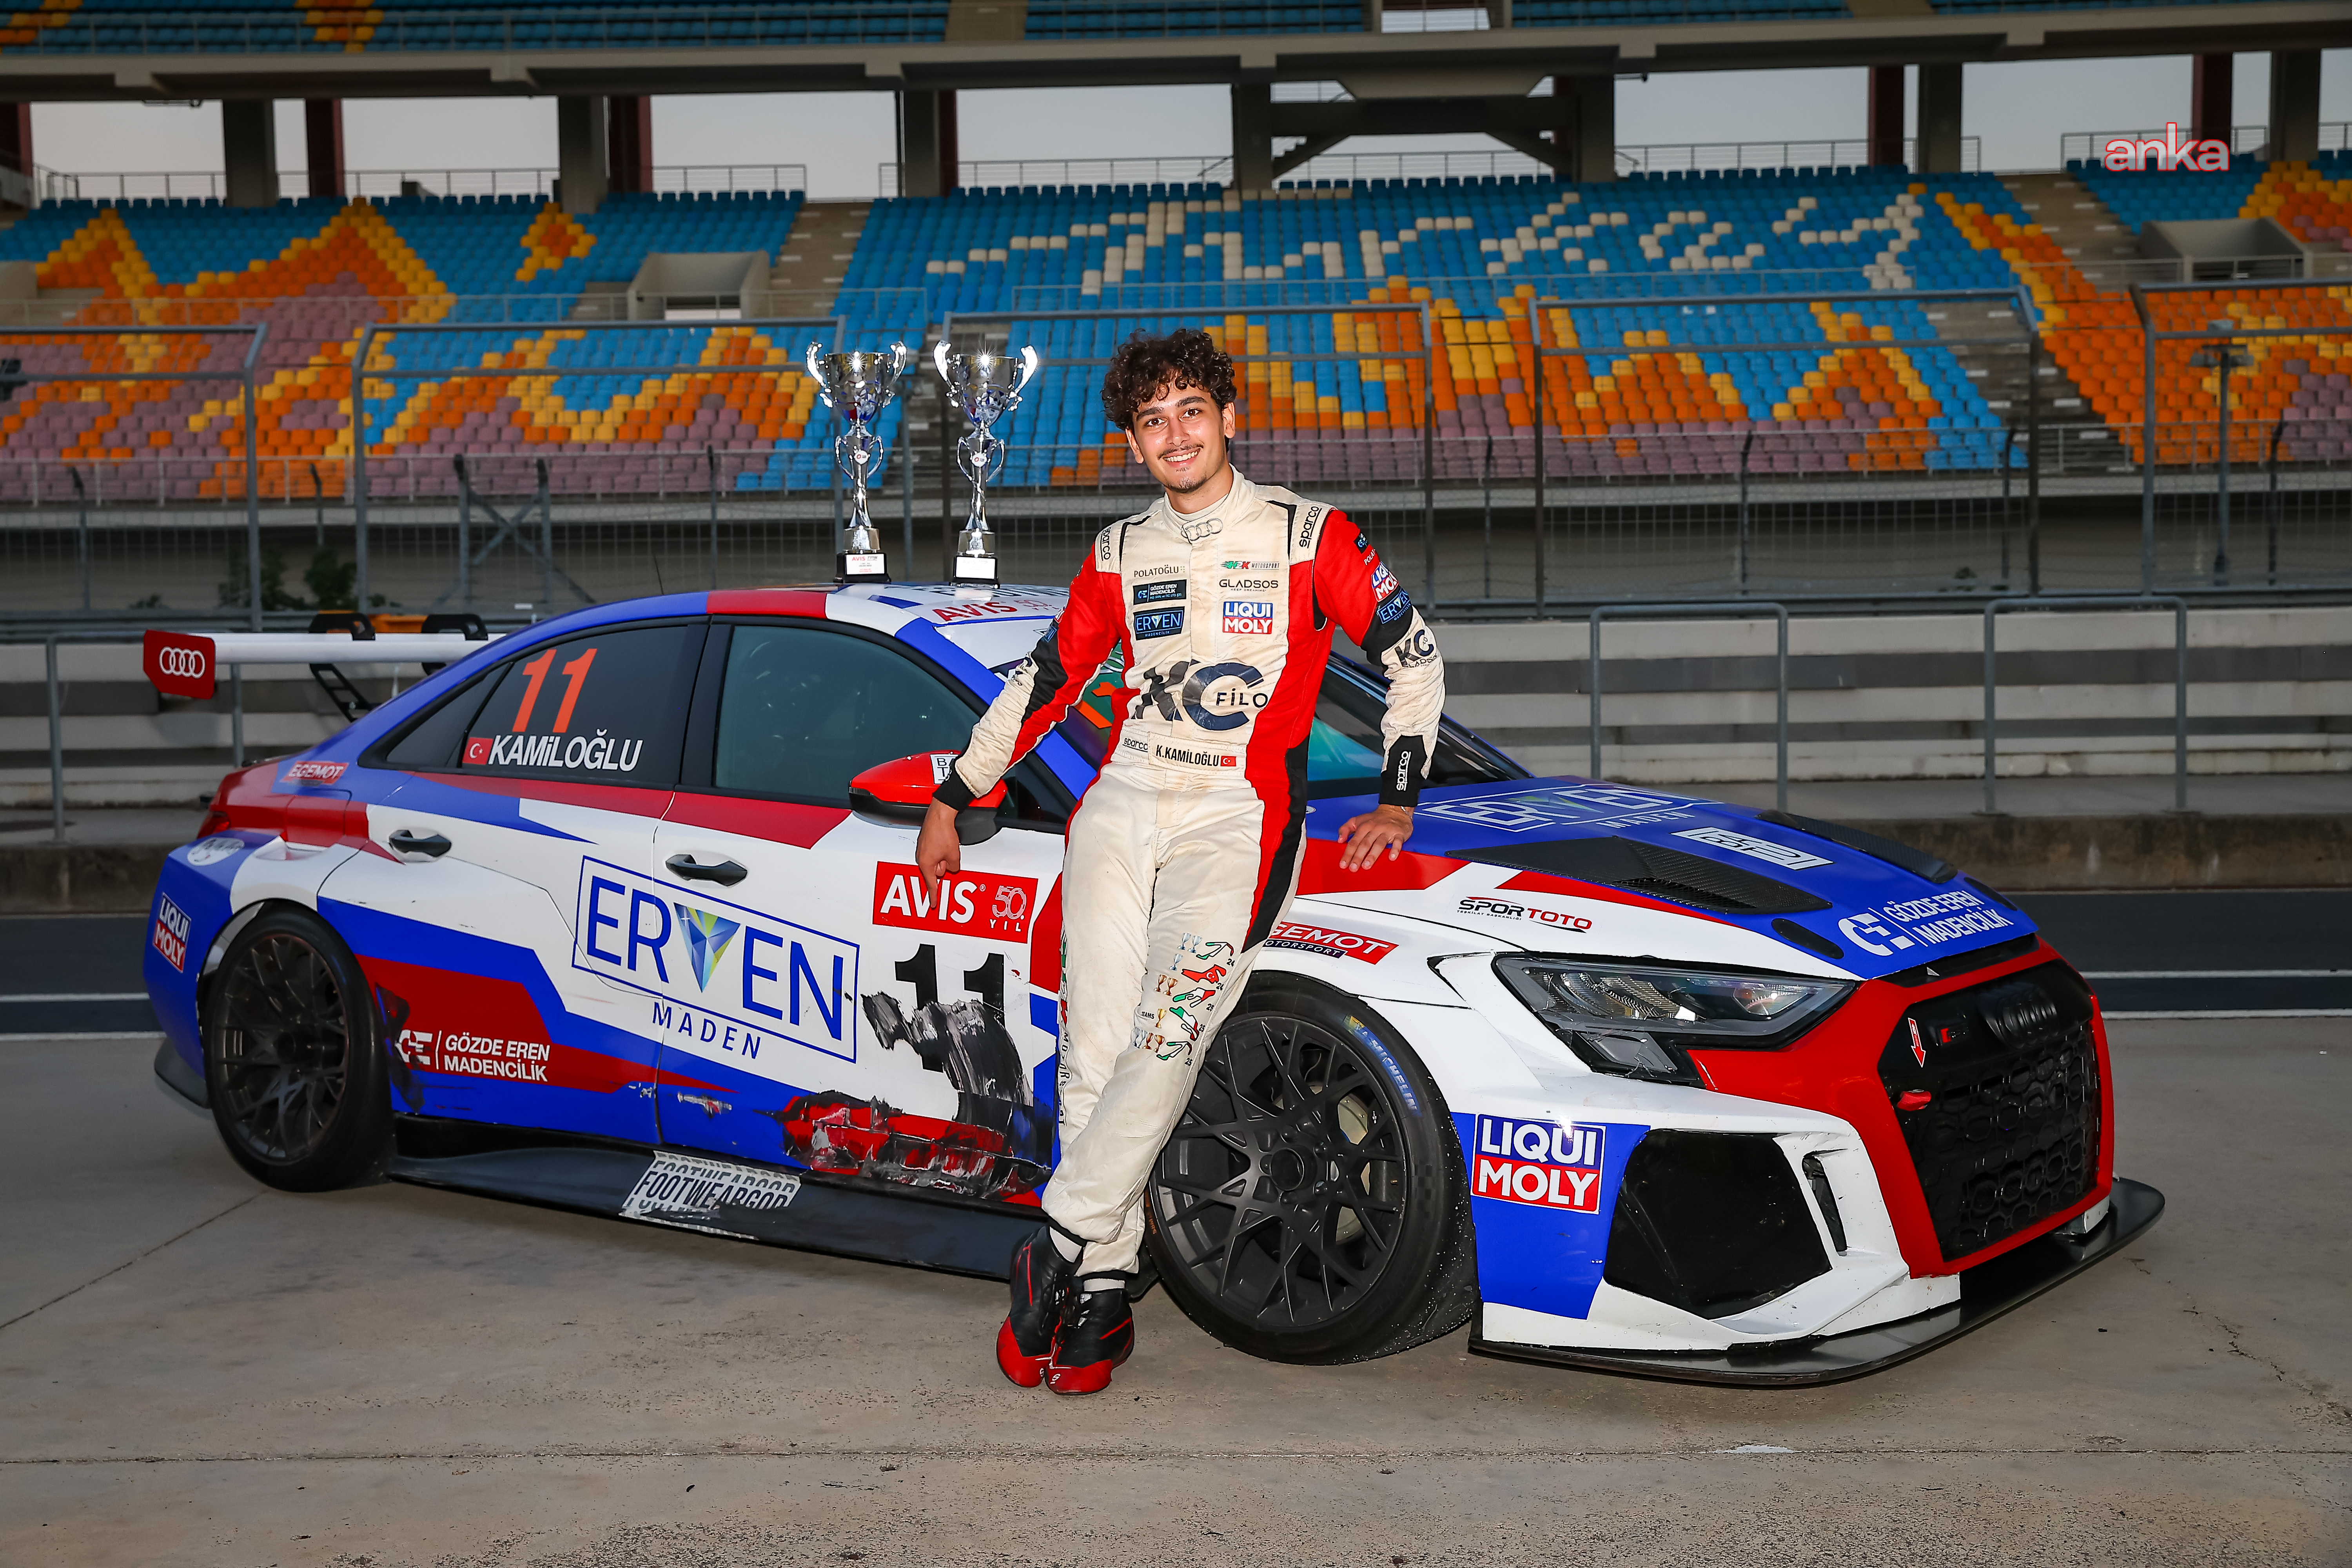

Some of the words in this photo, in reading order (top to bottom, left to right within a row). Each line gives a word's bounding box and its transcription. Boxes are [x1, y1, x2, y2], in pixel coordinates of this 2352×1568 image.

[1299, 506, 1322, 548] sparco
[1364, 549, 1376, 565] POLAT
[1134, 564, 1179, 577] POLATOĞLU
[1219, 579, 1278, 588] GLADSOS
[933, 602, 1018, 622] AVIS
[1225, 603, 1271, 618] LIQUI
[1137, 613, 1181, 631] ERVEN
[1225, 618, 1272, 633] MOLY
[1394, 629, 1434, 667] KC
[512, 649, 597, 733] 11
[1131, 659, 1264, 731] KC
[488, 728, 643, 771] KAMİLOĞLU
[1122, 738, 1148, 752] sparco
[1156, 745, 1219, 766] K.KAMİLOĞLU
[289, 764, 344, 779] EGEMOT
[1396, 751, 1411, 791] sparco
[1596, 811, 1695, 828] MADEN
[880, 875, 978, 924] AVIS
[1883, 898, 1949, 922] GÖZDE
[160, 900, 189, 942] LIQUI
[1459, 899, 1525, 917] SPOR
[1527, 908, 1592, 929] TOTO
[990, 919, 1021, 932] YIL
[1912, 908, 2014, 944] MADENCİLİK
[154, 922, 185, 966] MOLY
[1265, 940, 1340, 956] OTORSPORT
[587, 875, 844, 1041] ERVEN
[1227, 958, 1235, 967] 24
[1216, 982, 1224, 991] 24
[1141, 1011, 1155, 1020] TEAMS
[1206, 1003, 1214, 1012] 25
[652, 1002, 762, 1060] MADEN
[1198, 1024, 1206, 1033] 25
[445, 1032, 503, 1056] GÖZDE
[506, 1040, 550, 1061] EREN
[444, 1054, 548, 1082] MADENCİLİK
[1185, 1058, 1193, 1067] 25
[1481, 1118, 1597, 1167] LIQUI
[1479, 1159, 1598, 1207] MOLY
